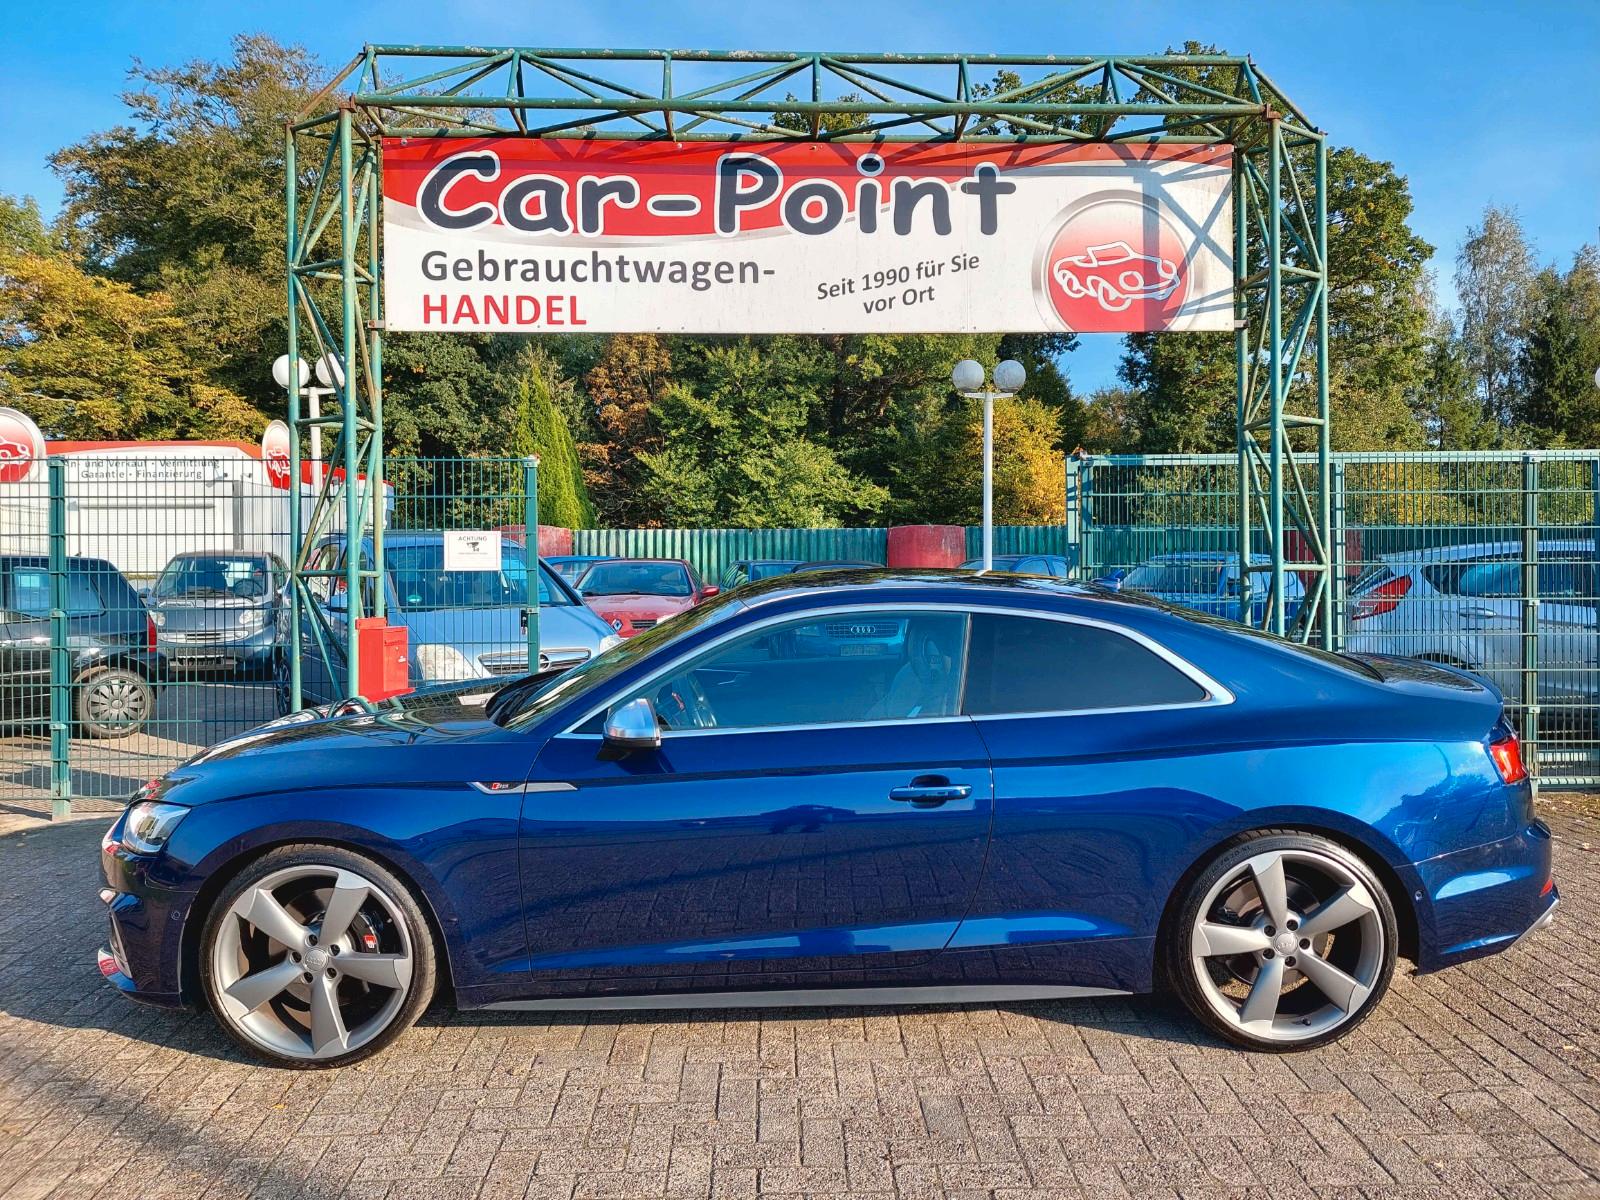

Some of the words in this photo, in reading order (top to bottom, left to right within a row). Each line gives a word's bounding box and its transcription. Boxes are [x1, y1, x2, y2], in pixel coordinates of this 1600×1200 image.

[417, 150, 1017, 237] Car-Point
[422, 250, 775, 291] Gebrauchtwagen-
[817, 277, 856, 300] Seit
[862, 266, 910, 291] 1990
[915, 261, 945, 281] für
[951, 253, 980, 274] Sie
[423, 294, 588, 326] HANDEL
[863, 296, 895, 314] vor
[902, 286, 935, 306] Ort
[81, 470, 125, 479] Garante
[136, 469, 202, 480] Finanzierung
